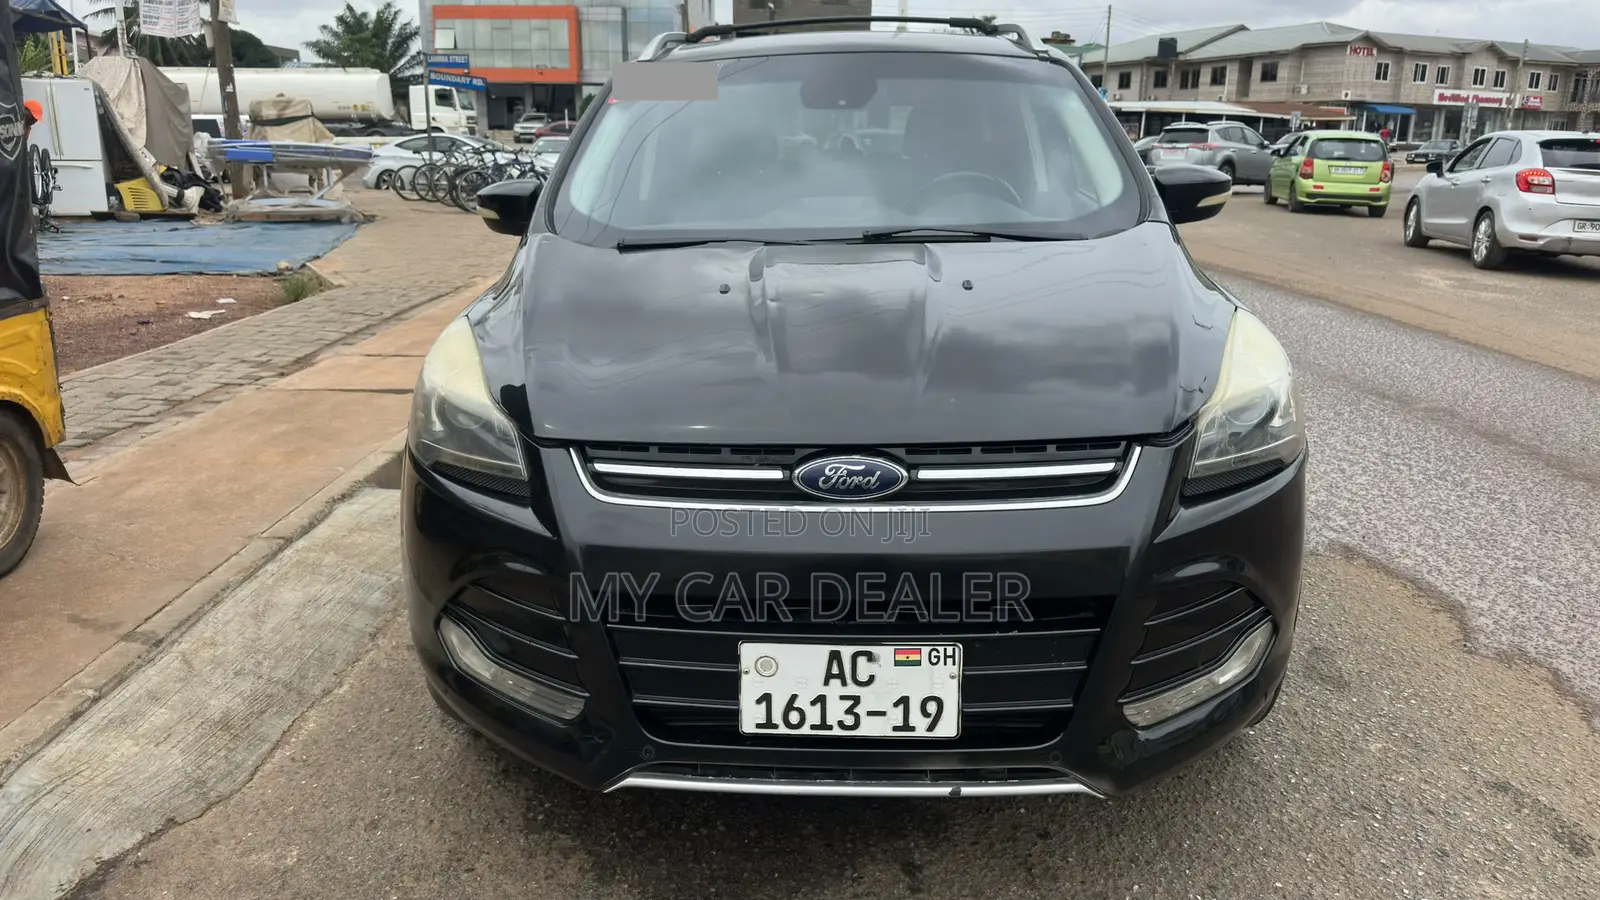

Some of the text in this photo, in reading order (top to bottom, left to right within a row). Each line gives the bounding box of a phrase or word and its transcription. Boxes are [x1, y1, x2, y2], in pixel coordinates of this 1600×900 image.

[1349, 45, 1374, 57] HOTEL
[449, 55, 468, 63] STREET
[430, 71, 471, 83] BOUNDARY
[1577, 222, 1587, 230] GR
[819, 463, 881, 490] Ford
[928, 647, 957, 666] GH
[823, 649, 876, 687] AC
[755, 692, 944, 732] 1613-19
